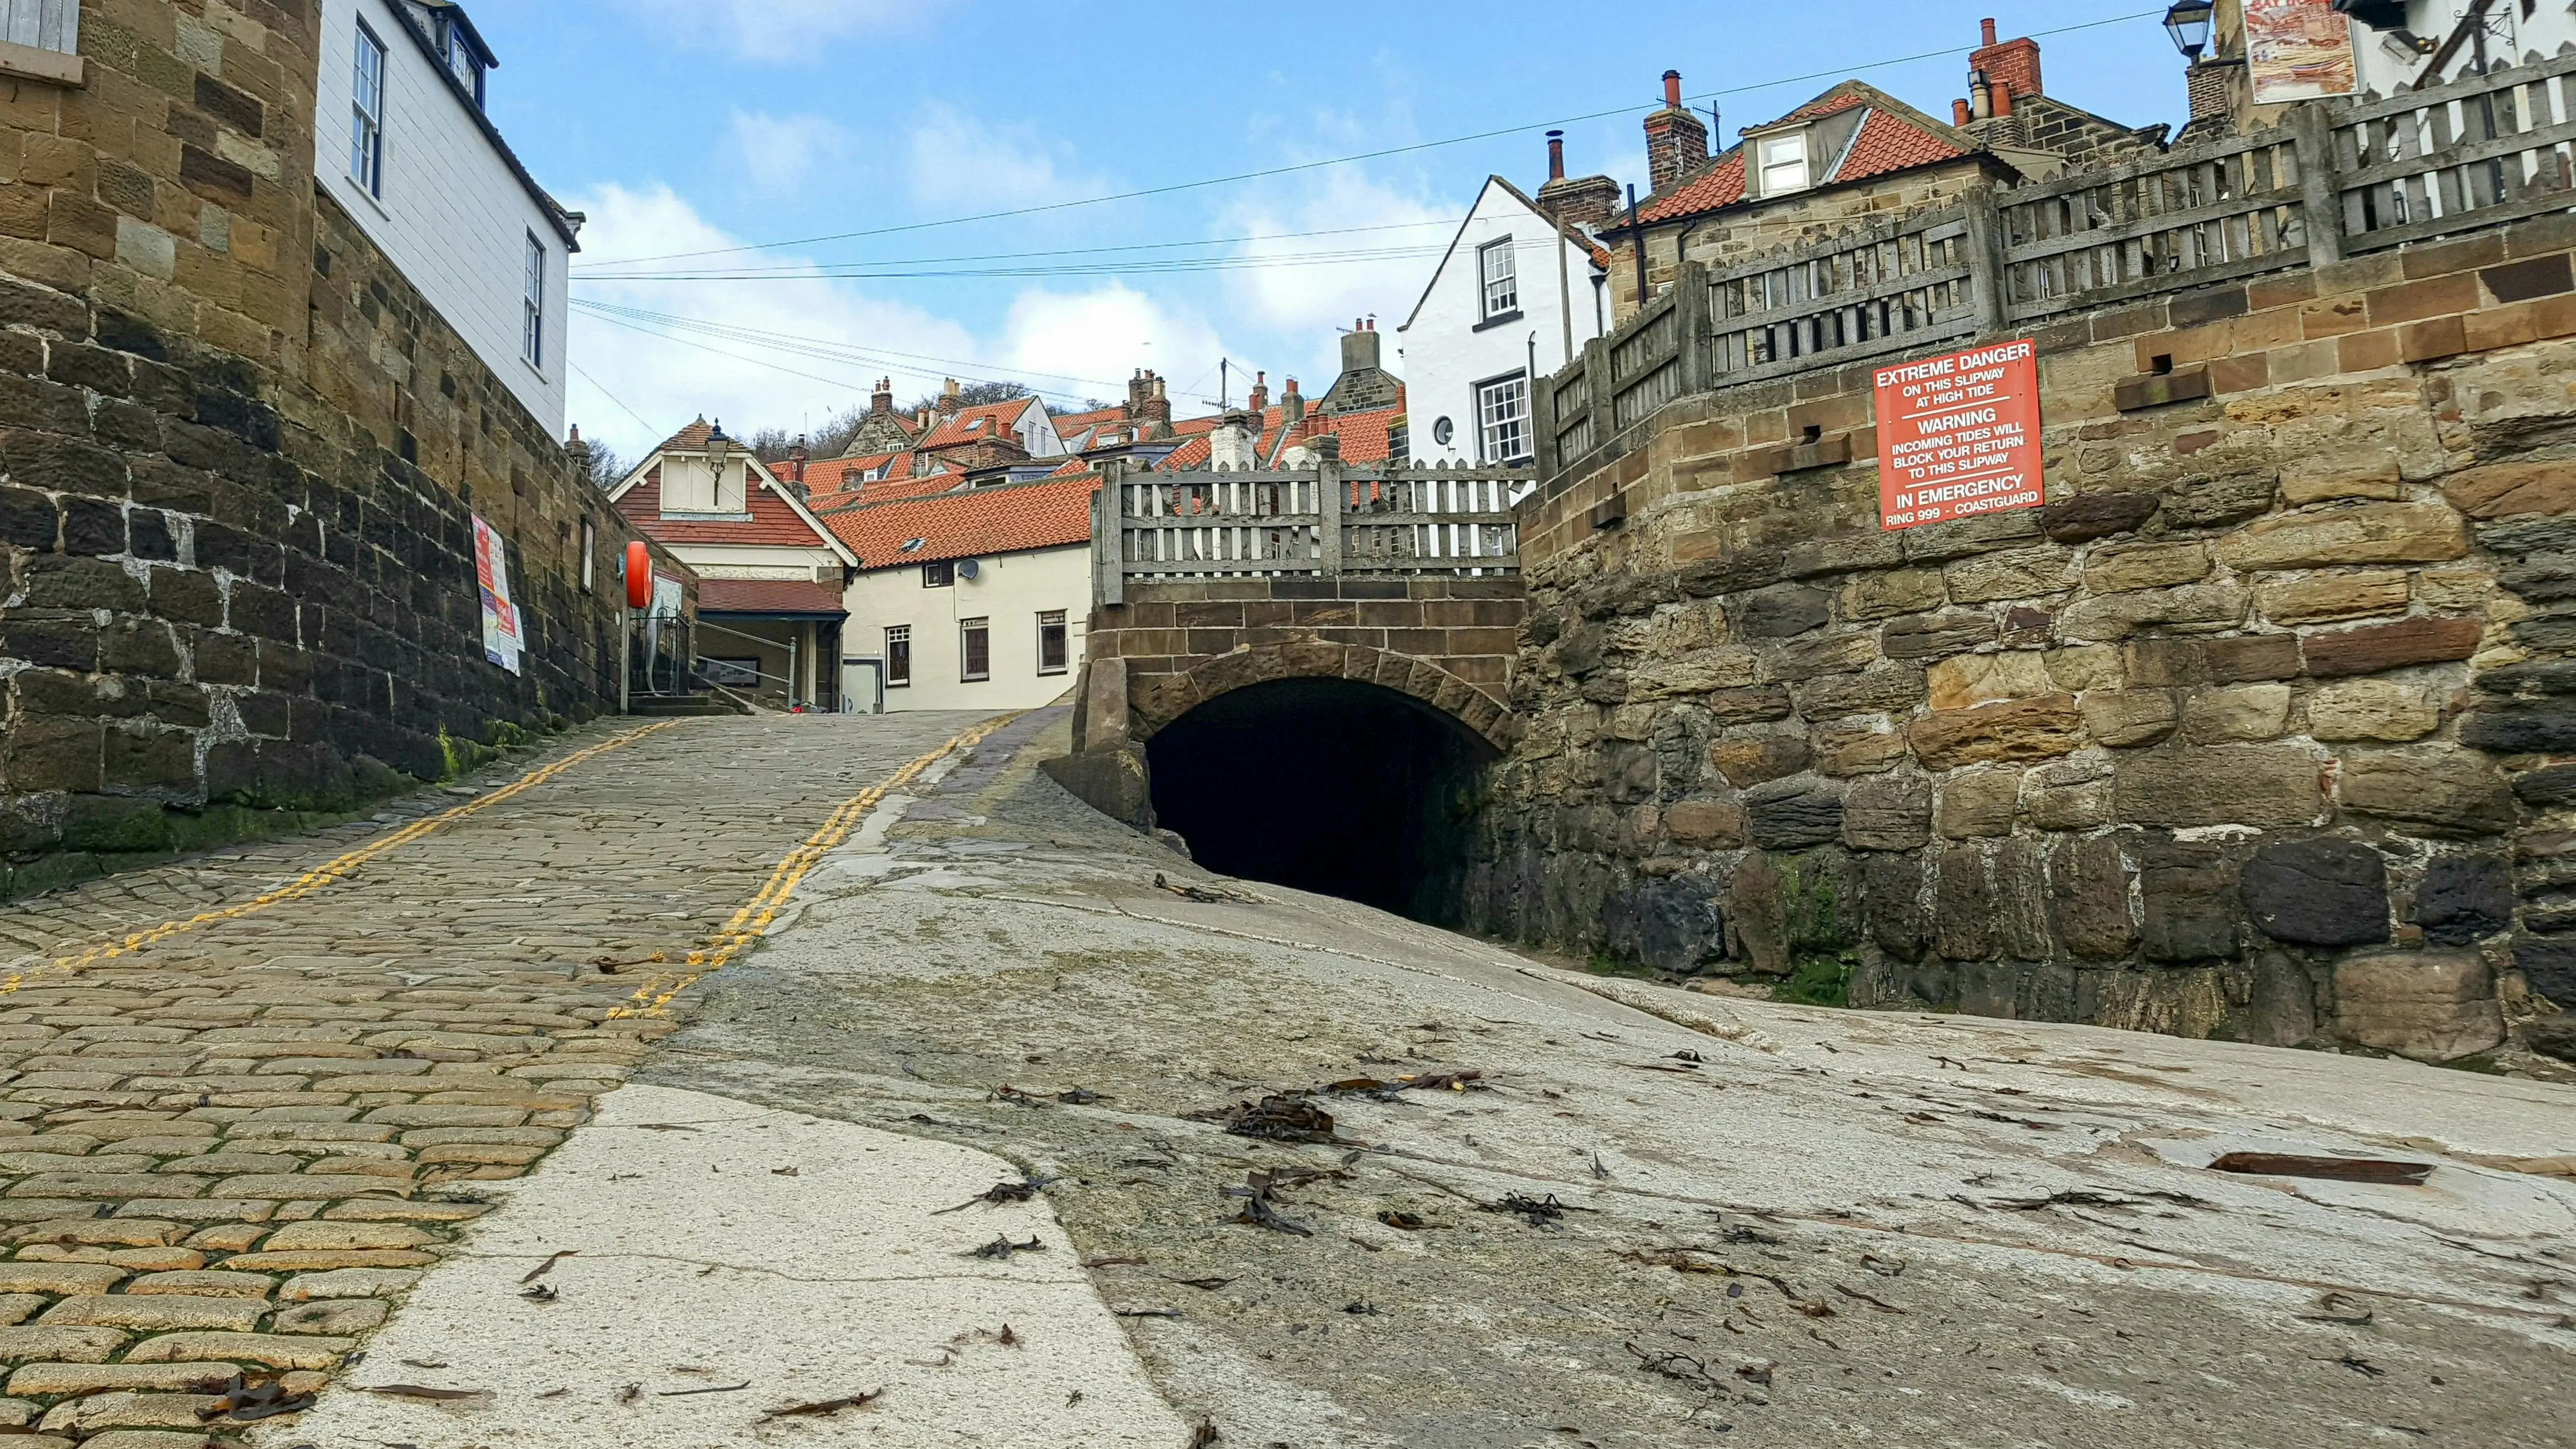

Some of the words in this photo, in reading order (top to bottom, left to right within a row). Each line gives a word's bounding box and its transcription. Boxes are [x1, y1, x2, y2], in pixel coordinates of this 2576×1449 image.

[1877, 358, 1955, 388] EXTREME
[1960, 343, 2030, 371] DANGER
[1902, 384, 1920, 397] ON
[1925, 378, 1952, 393] THIS
[1955, 367, 2005, 387] SLIPWAY
[1916, 397, 1929, 409] AT
[1933, 389, 1963, 405] HIGH
[1966, 383, 1994, 398] TIDE
[1917, 408, 1996, 435] WARNING
[1892, 435, 1953, 455] INCOMING
[1955, 428, 1991, 443] TIDES
[1993, 422, 2024, 436] WILL
[1894, 454, 1934, 469] BLOCK
[1937, 445, 1970, 461] YOUR
[1974, 435, 2024, 453] RETURN
[1908, 468, 1925, 479] TO
[1928, 462, 1955, 476] THIS
[1958, 452, 2009, 471] SLIPWAY
[1896, 492, 1913, 509] IN
[1918, 474, 2024, 506] EMERGENCY
[1886, 512, 1914, 527] RING
[1917, 508, 1940, 521] 999
[1955, 491, 2038, 515] COASTGUARD
